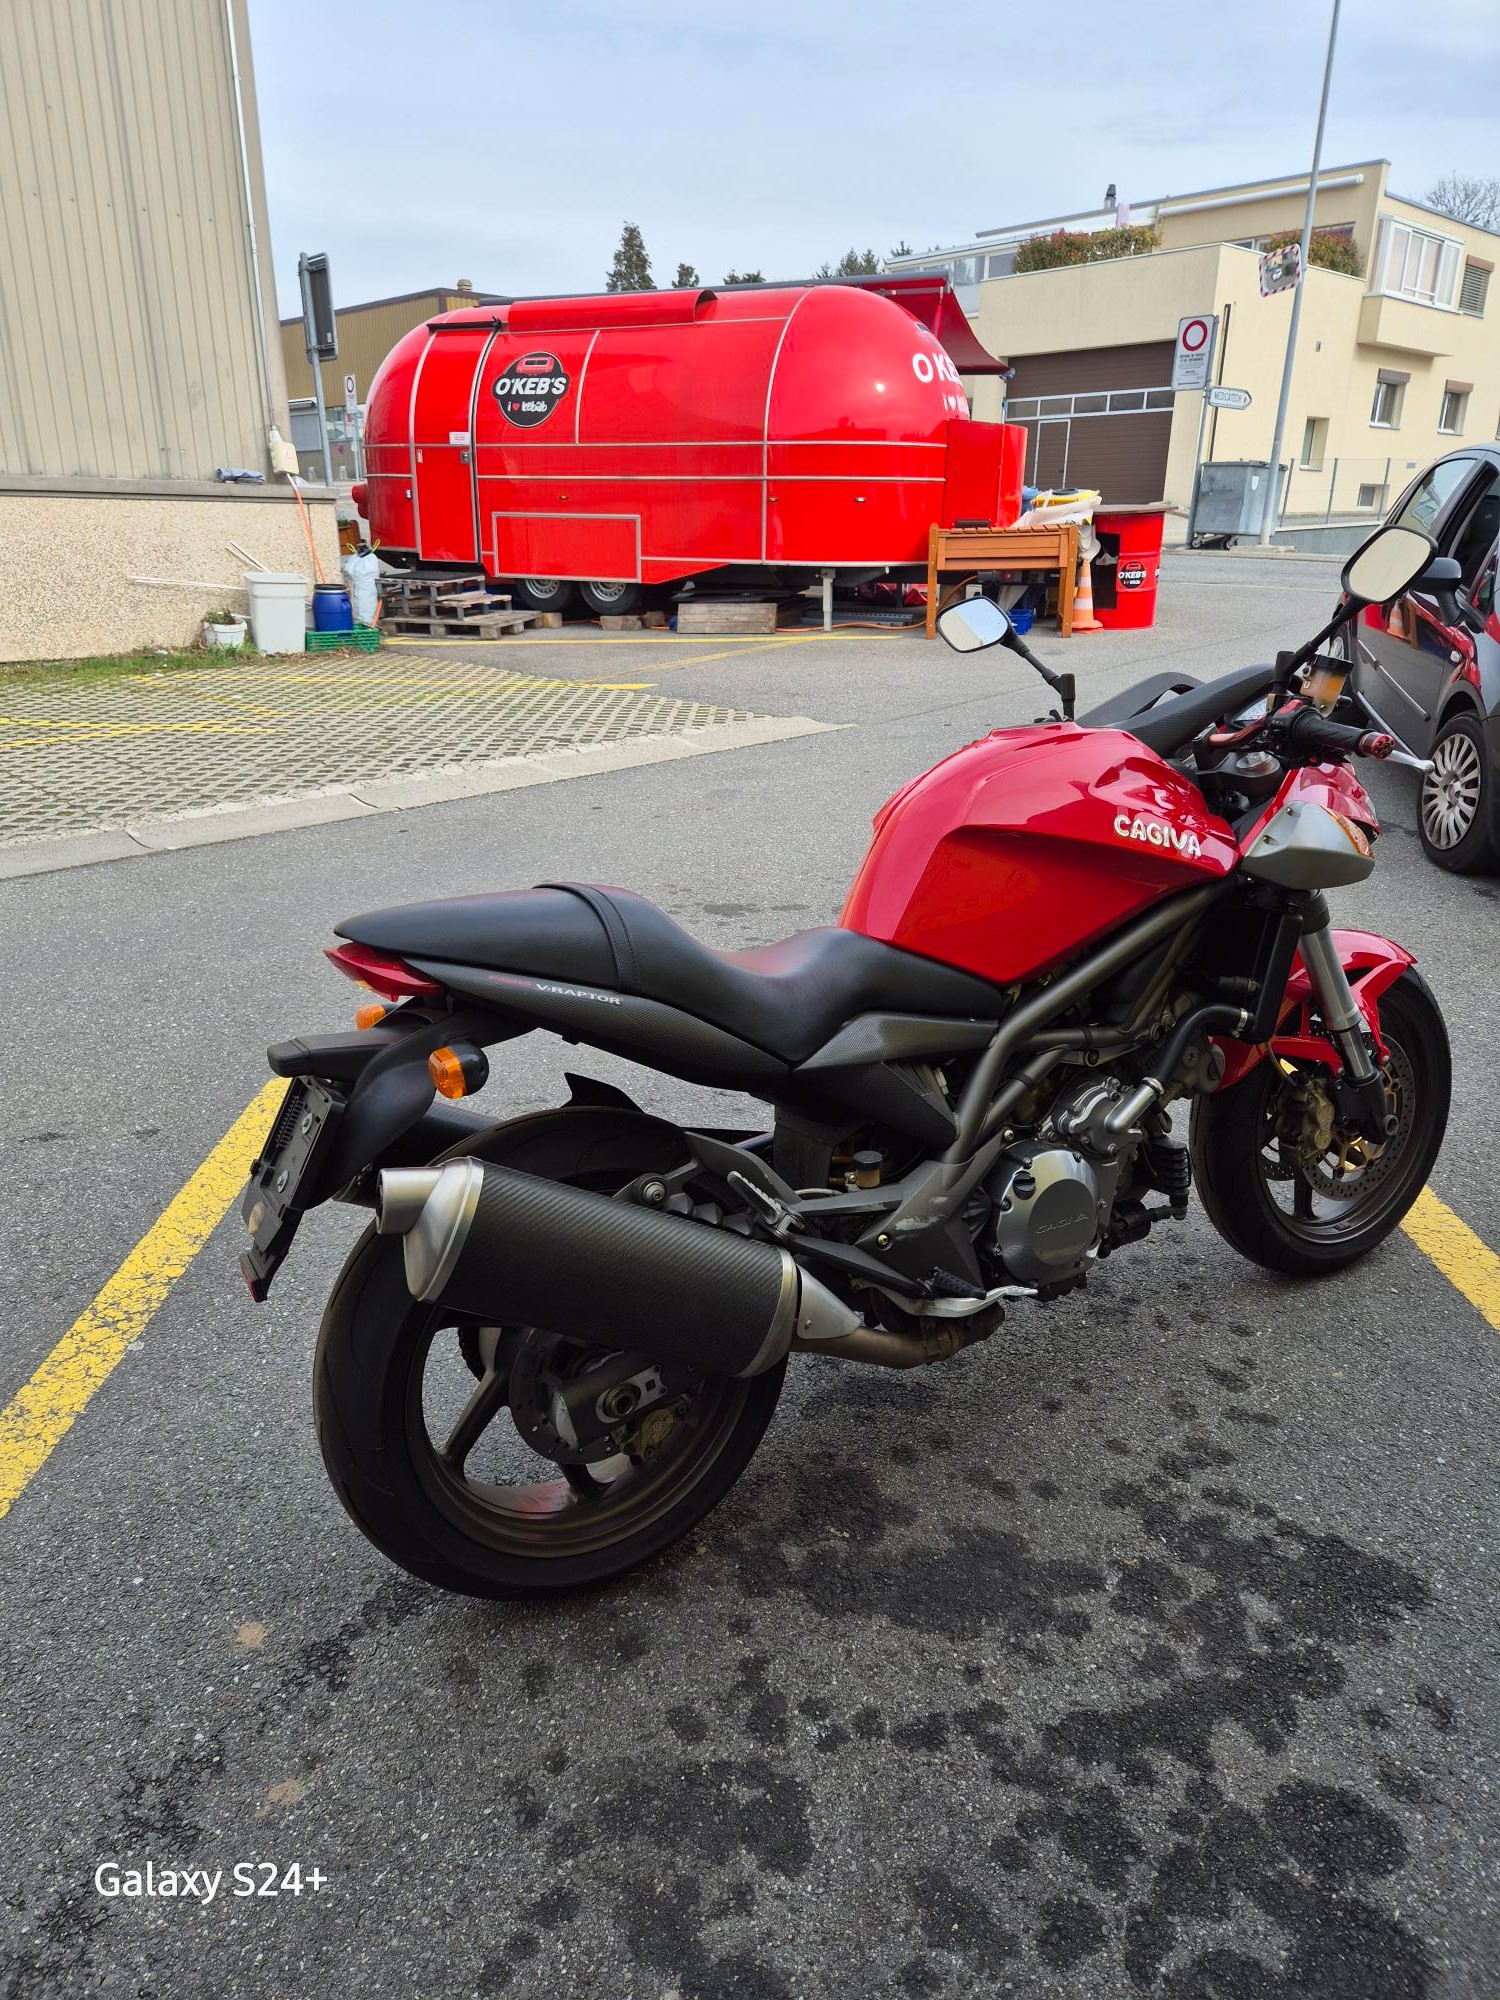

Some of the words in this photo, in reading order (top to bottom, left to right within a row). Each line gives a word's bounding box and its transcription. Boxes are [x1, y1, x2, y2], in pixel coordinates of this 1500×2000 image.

[495, 376, 567, 395] O'KEB'S
[521, 400, 548, 413] kebab
[1117, 570, 1147, 579] O'KEB'S
[1114, 814, 1202, 857] CAGIVA
